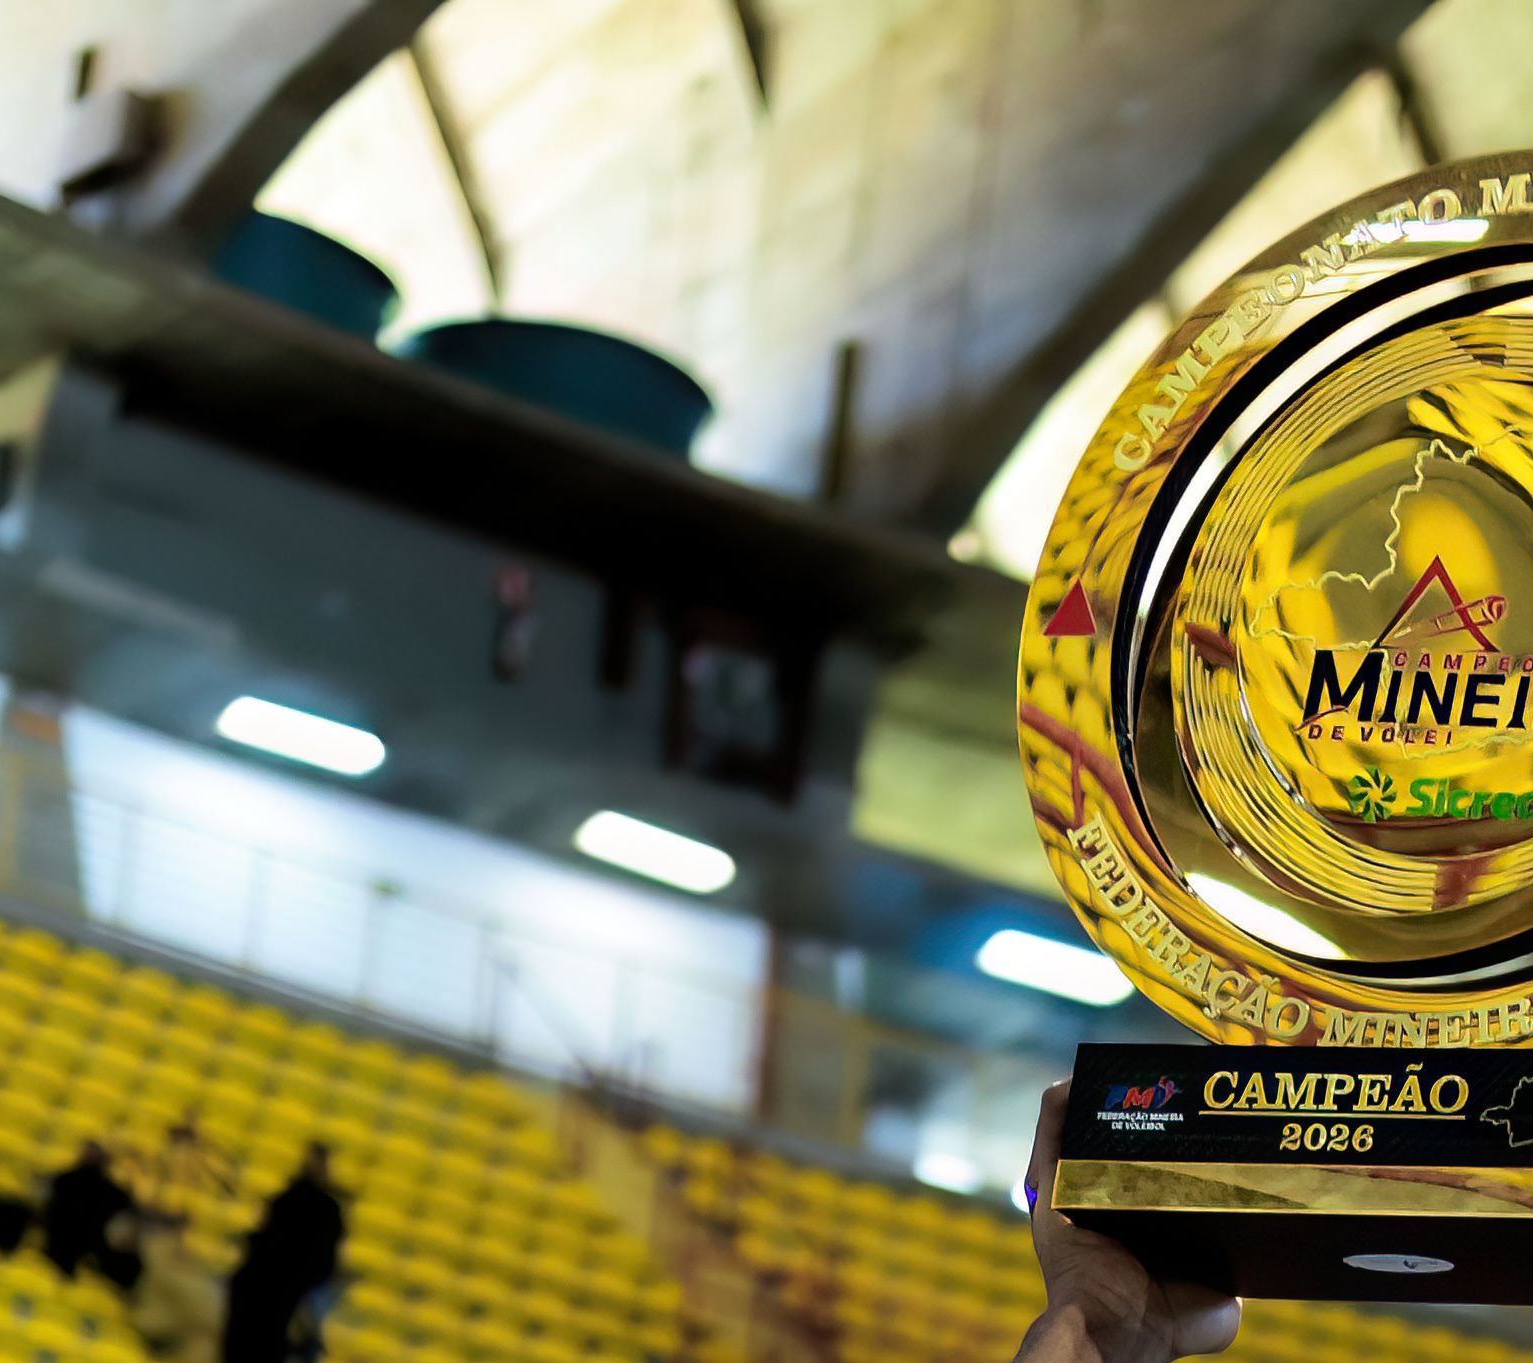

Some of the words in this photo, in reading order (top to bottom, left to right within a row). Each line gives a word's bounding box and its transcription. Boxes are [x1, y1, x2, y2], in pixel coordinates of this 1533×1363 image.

[1113, 189, 1460, 473] CAMPEONATO
[1308, 724, 1345, 741] DE
[1067, 812, 1311, 1038] FEDERAÇÃO
[1203, 1062, 1470, 1114] CAMPEÃO
[1279, 1122, 1374, 1152] 2026
